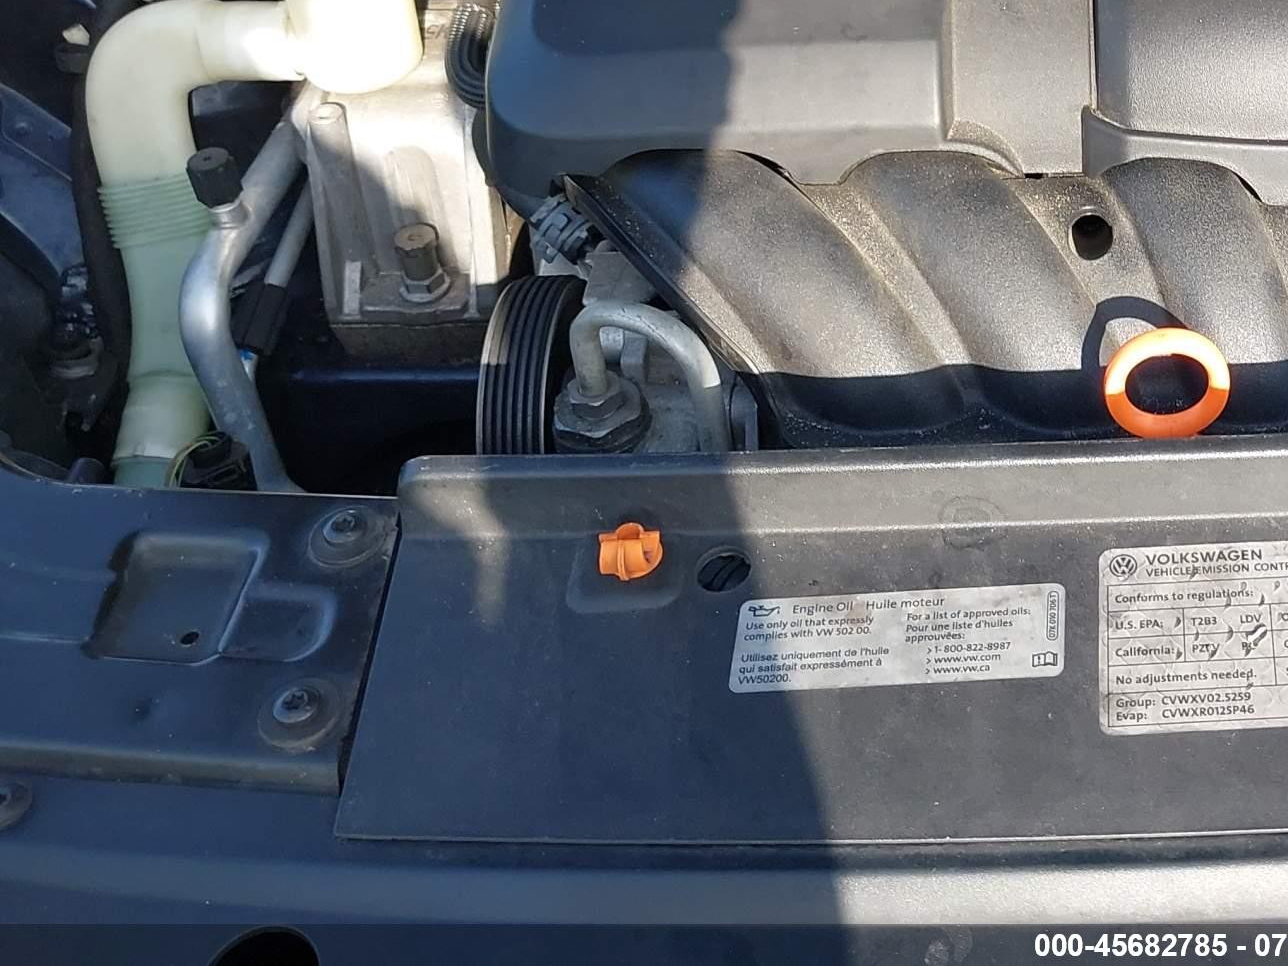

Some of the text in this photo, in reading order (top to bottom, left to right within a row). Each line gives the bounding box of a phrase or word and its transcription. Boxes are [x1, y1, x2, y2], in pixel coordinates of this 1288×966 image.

[1146, 549, 1263, 566] VOLKSWAGEN
[1146, 567, 1193, 577] VEHICLE
[1115, 589, 1254, 604] Conforms to regulations:
[792, 597, 945, 616] Engine Oil Huile moteur
[907, 606, 1031, 622] For a list of approved oils:
[1240, 614, 1262, 624] LDV
[746, 614, 874, 632] Use only oil that expressly
[906, 618, 1014, 633] Pour une liste d'huiles
[1115, 619, 1164, 631] U.S. EPA:
[1191, 617, 1218, 627] T2B3
[744, 625, 872, 643] complies with VW 502 00.
[905, 632, 966, 645] approuvées:
[741, 645, 890, 664] Utilisez uniquement de l'huile
[934, 653, 1001, 665] www.vw.com
[1115, 647, 1176, 658] California:
[739, 665, 756, 676] qui
[758, 661, 798, 674] satisfait
[933, 664, 991, 675] www.vw.ca
[738, 673, 792, 685] VW50200.
[1116, 668, 1257, 685] No adjustments needed.
[1116, 697, 1156, 708] Group:
[1116, 711, 1148, 722] Evap:
